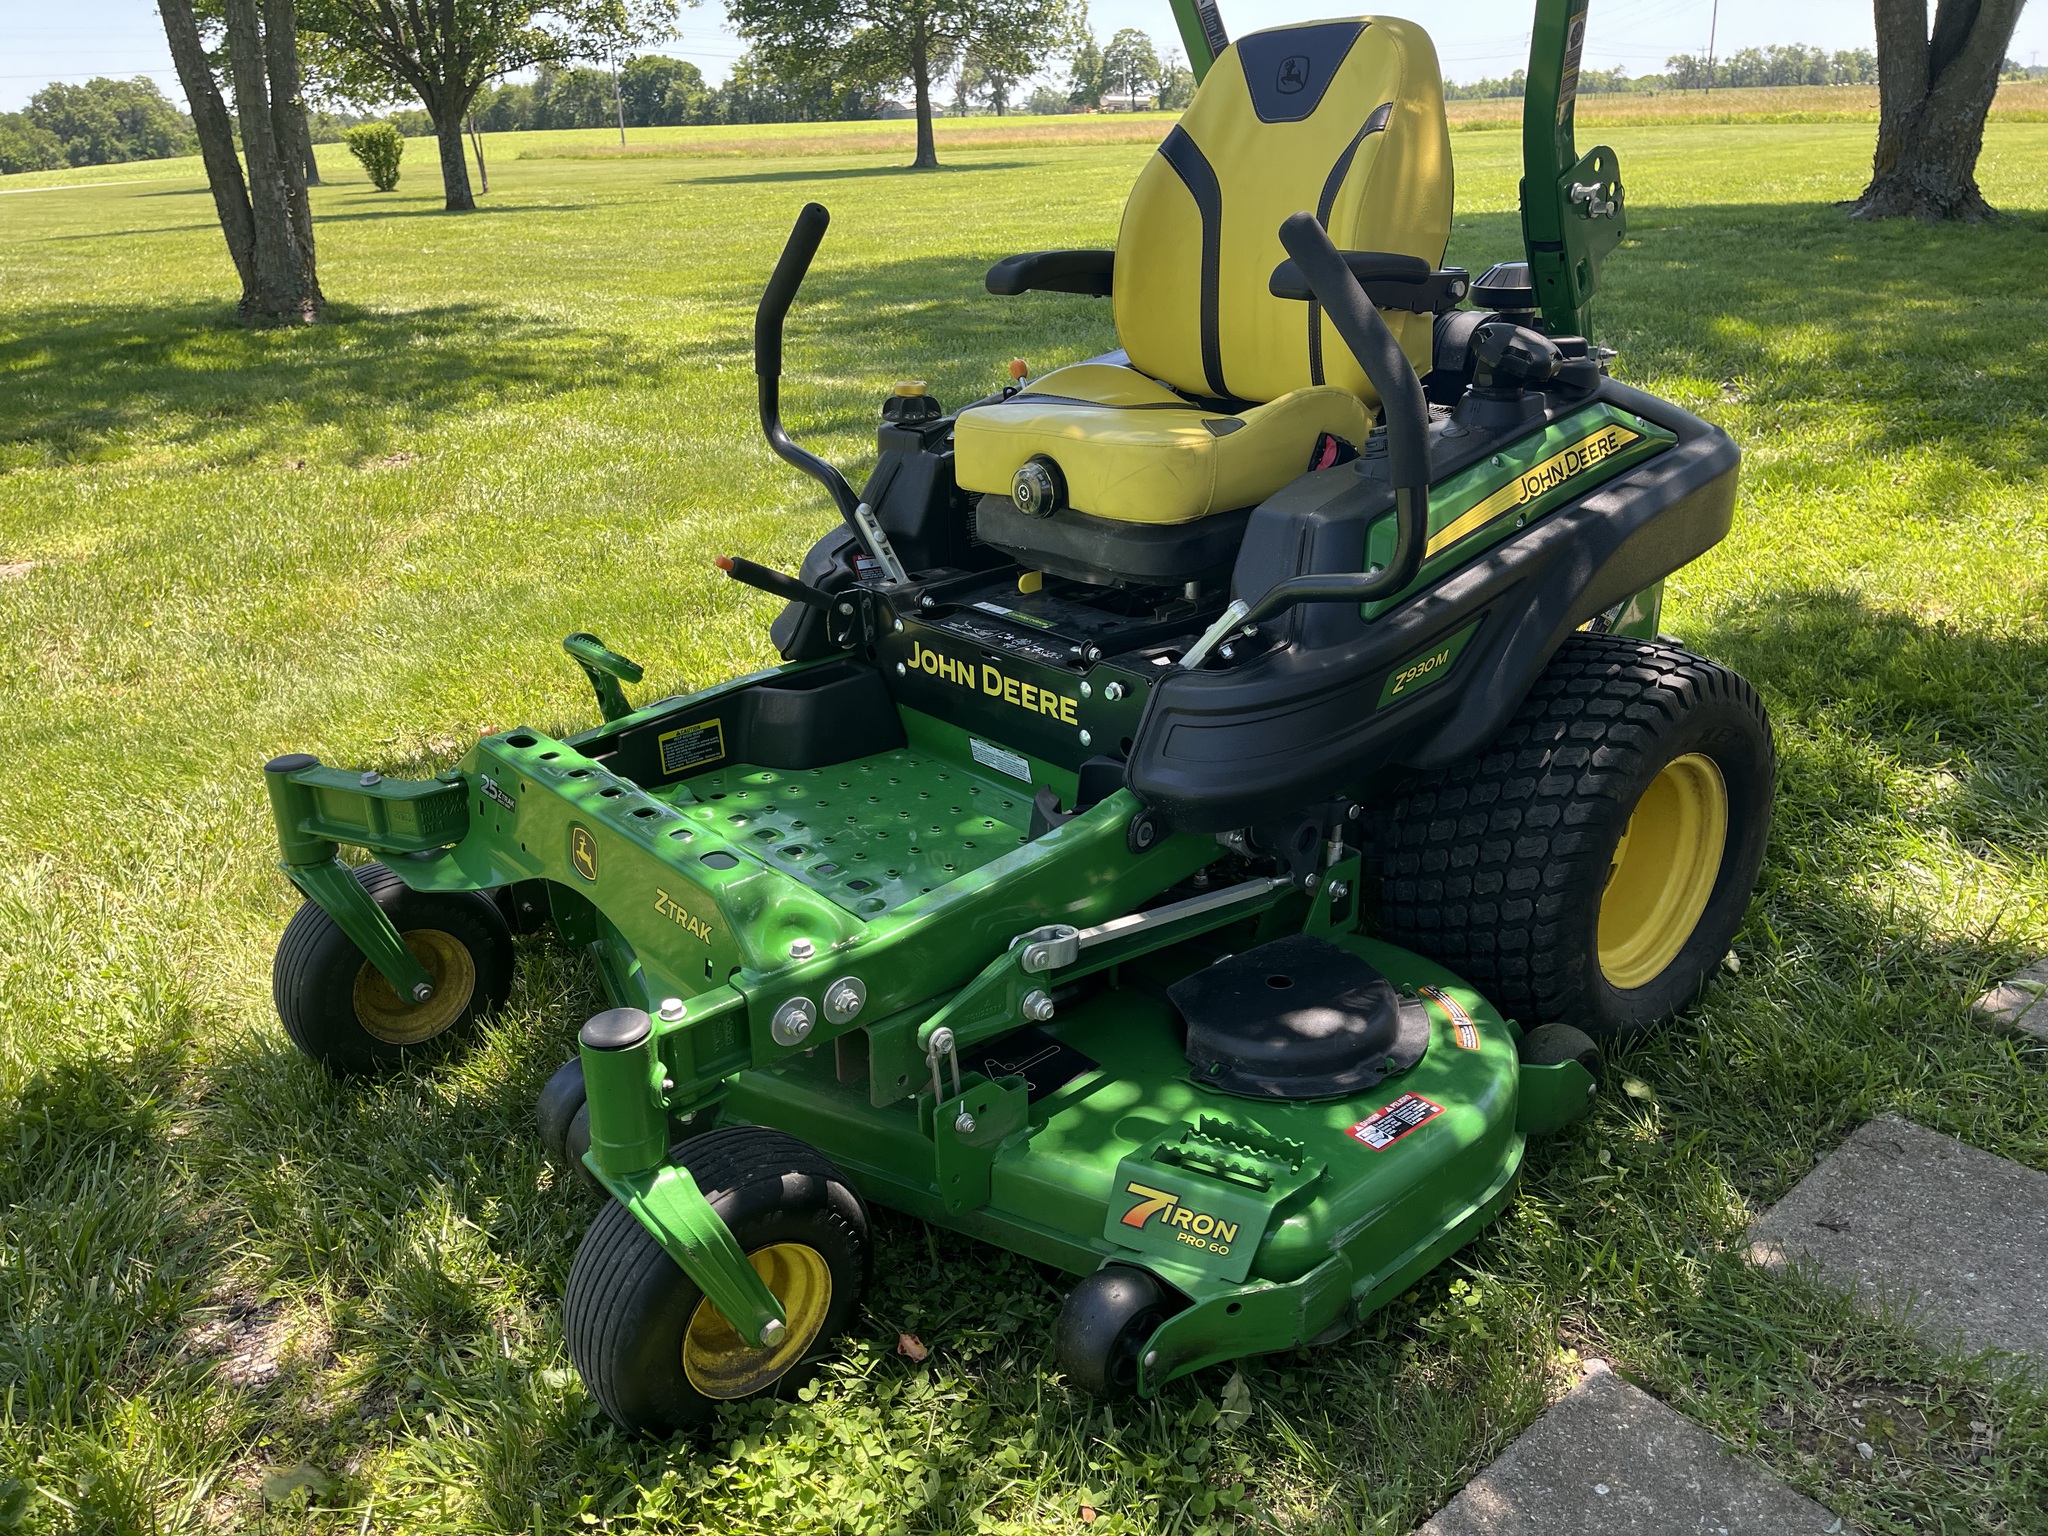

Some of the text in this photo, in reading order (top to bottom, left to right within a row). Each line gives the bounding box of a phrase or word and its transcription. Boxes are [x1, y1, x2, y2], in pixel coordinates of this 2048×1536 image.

[1518, 432, 1619, 505] JOHN DEERE
[907, 641, 1079, 726] JOHN DEERE
[1391, 648, 1449, 695] Z930M
[480, 773, 498, 800] 25
[654, 887, 714, 946] ZTRAK
[1390, 1094, 1412, 1108] PELIGRO
[1176, 1231, 1231, 1256] PRO 60
